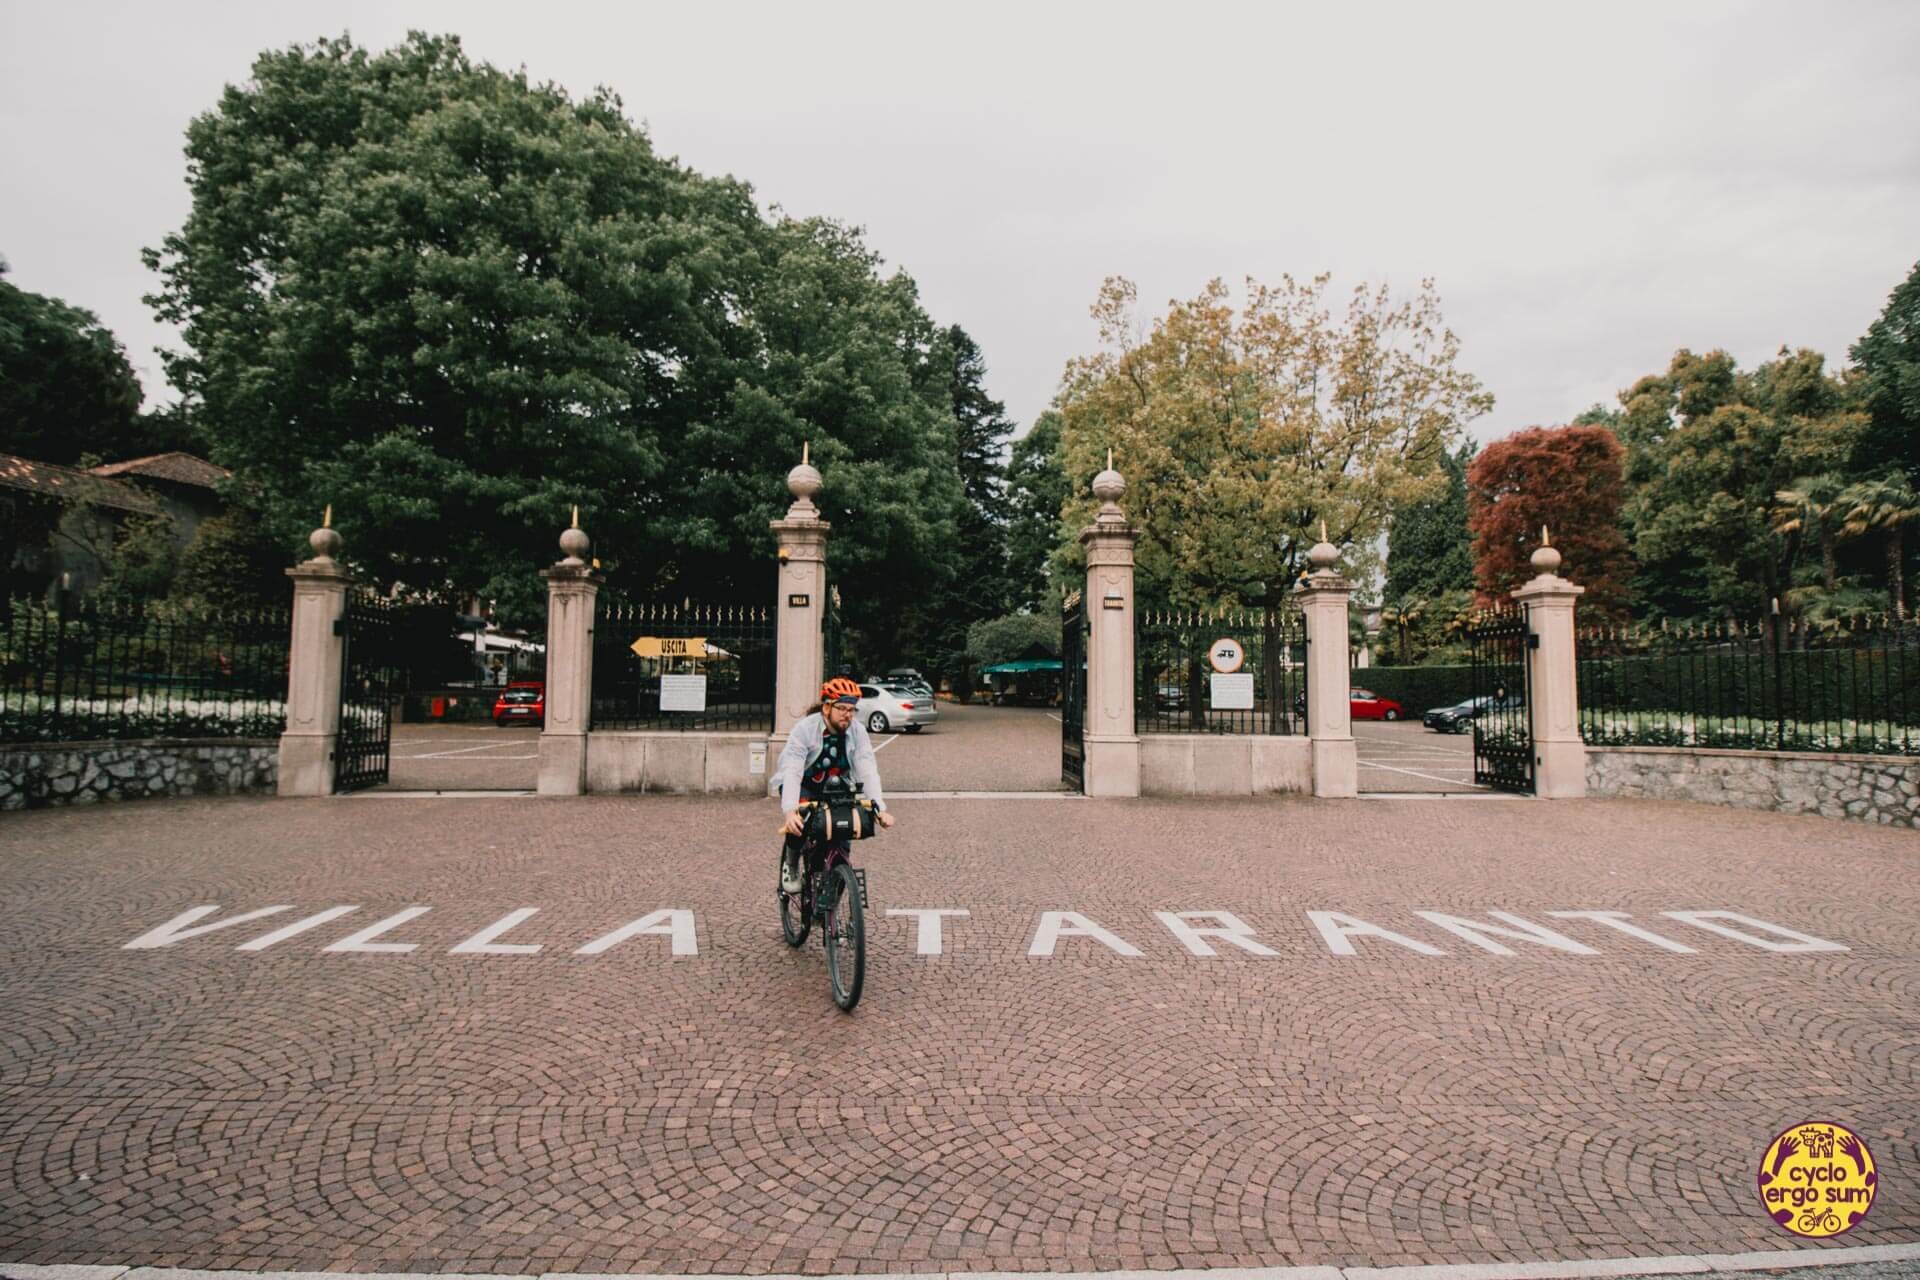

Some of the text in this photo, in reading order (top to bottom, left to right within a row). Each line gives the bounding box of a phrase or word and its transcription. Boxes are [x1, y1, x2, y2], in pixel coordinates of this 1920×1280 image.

[661, 639, 687, 654] USCITA
[120, 905, 1853, 957] VILLA TARANTO
